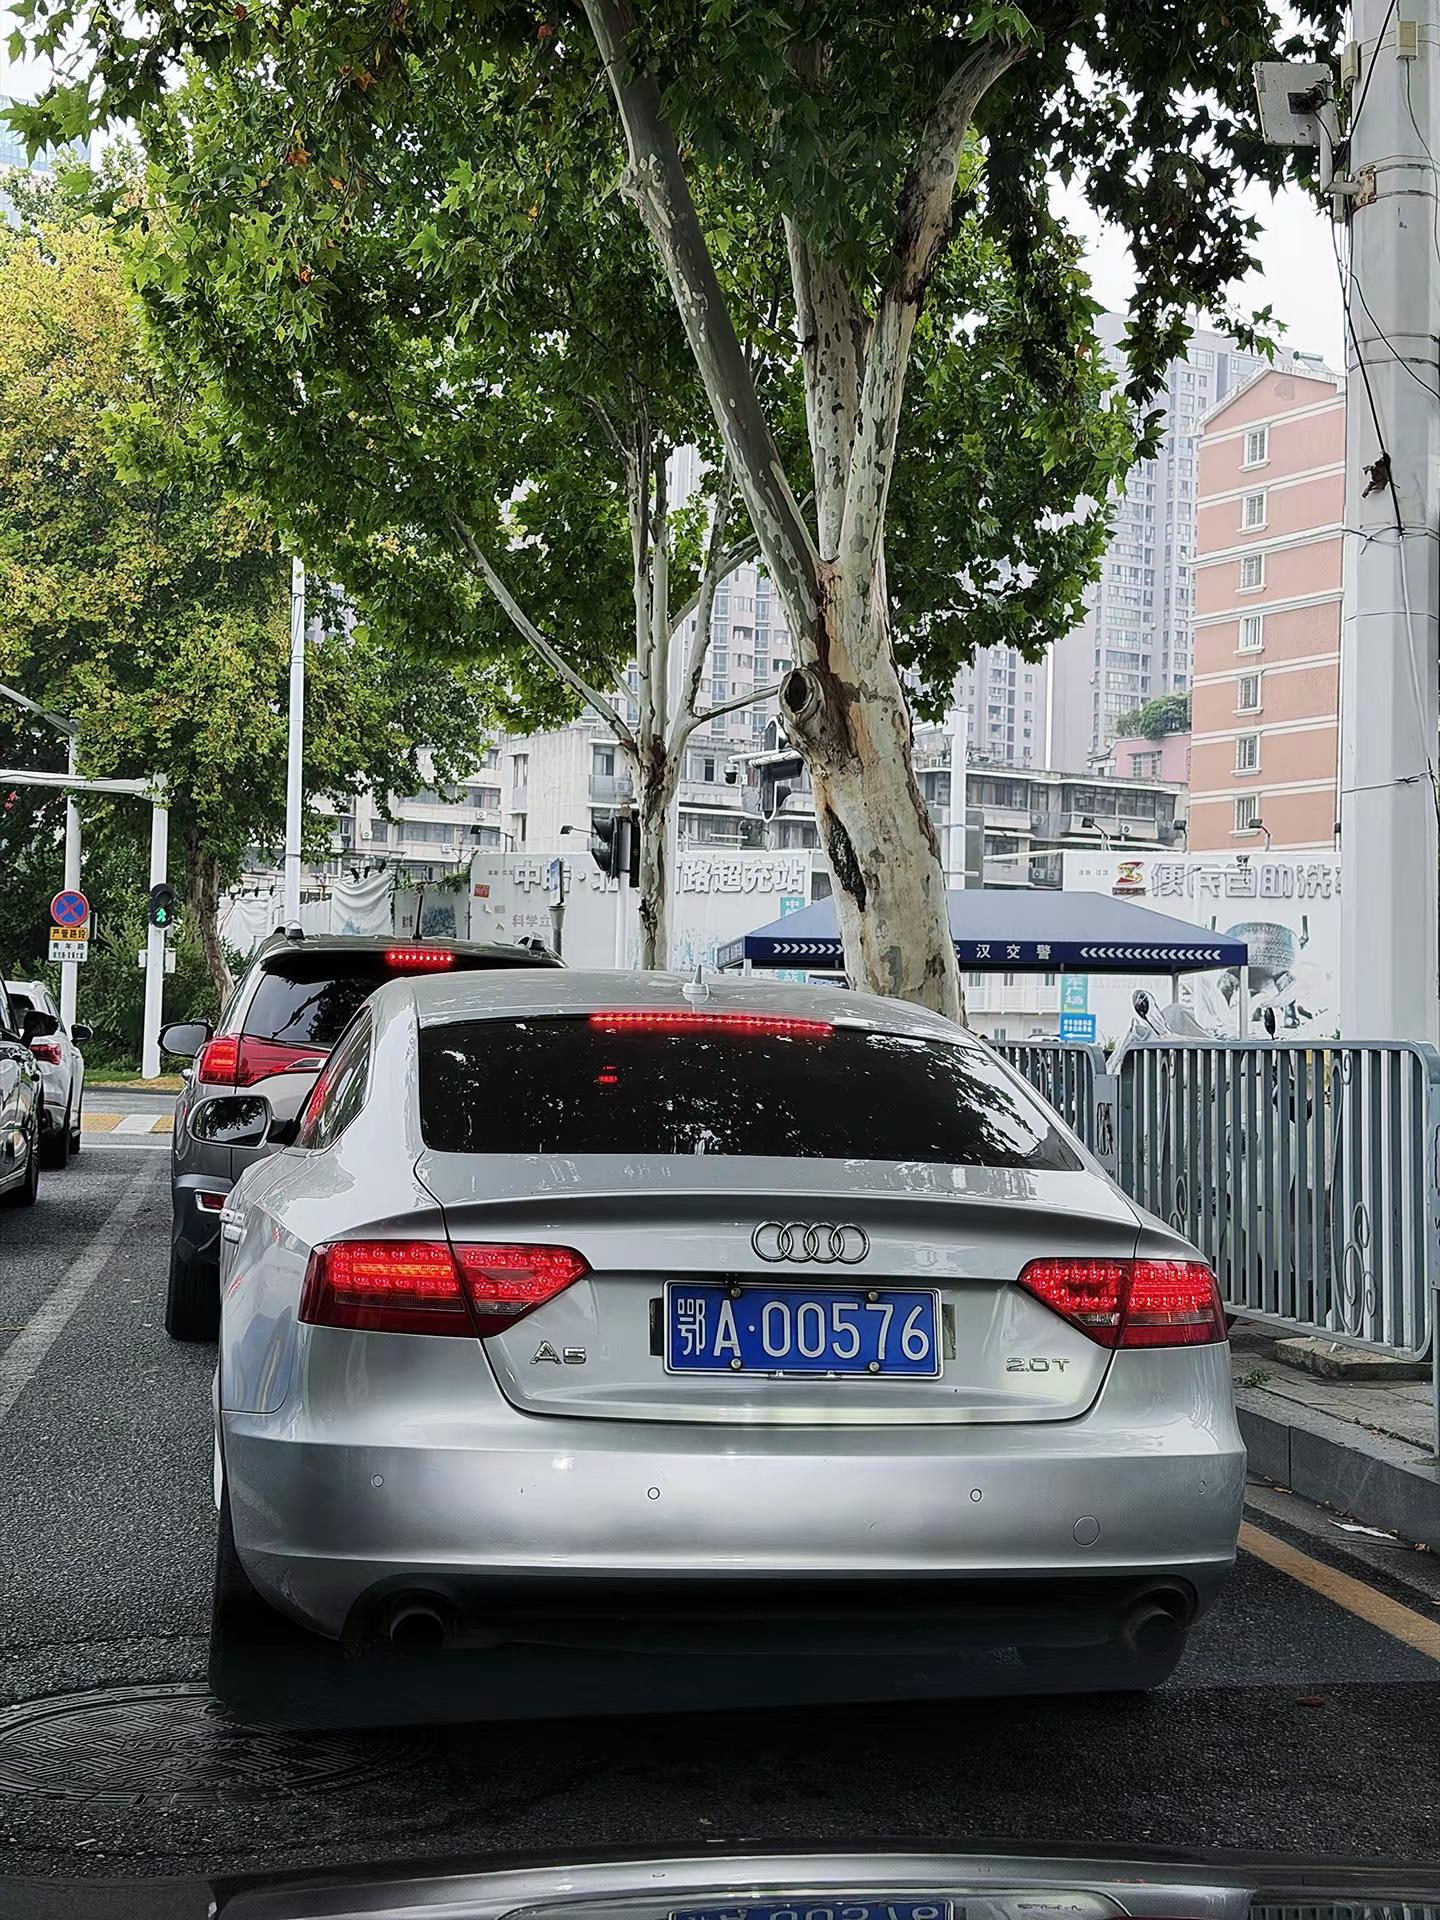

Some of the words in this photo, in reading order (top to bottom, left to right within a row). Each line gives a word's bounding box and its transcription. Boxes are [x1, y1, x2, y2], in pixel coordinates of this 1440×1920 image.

[1151, 862, 1341, 899] 便民自助洗
[52, 928, 86, 939] 严管路段
[677, 1298, 930, 1361] 鄂A·00576
[530, 1339, 588, 1366] A5
[1005, 1358, 1071, 1374] 2.0T
